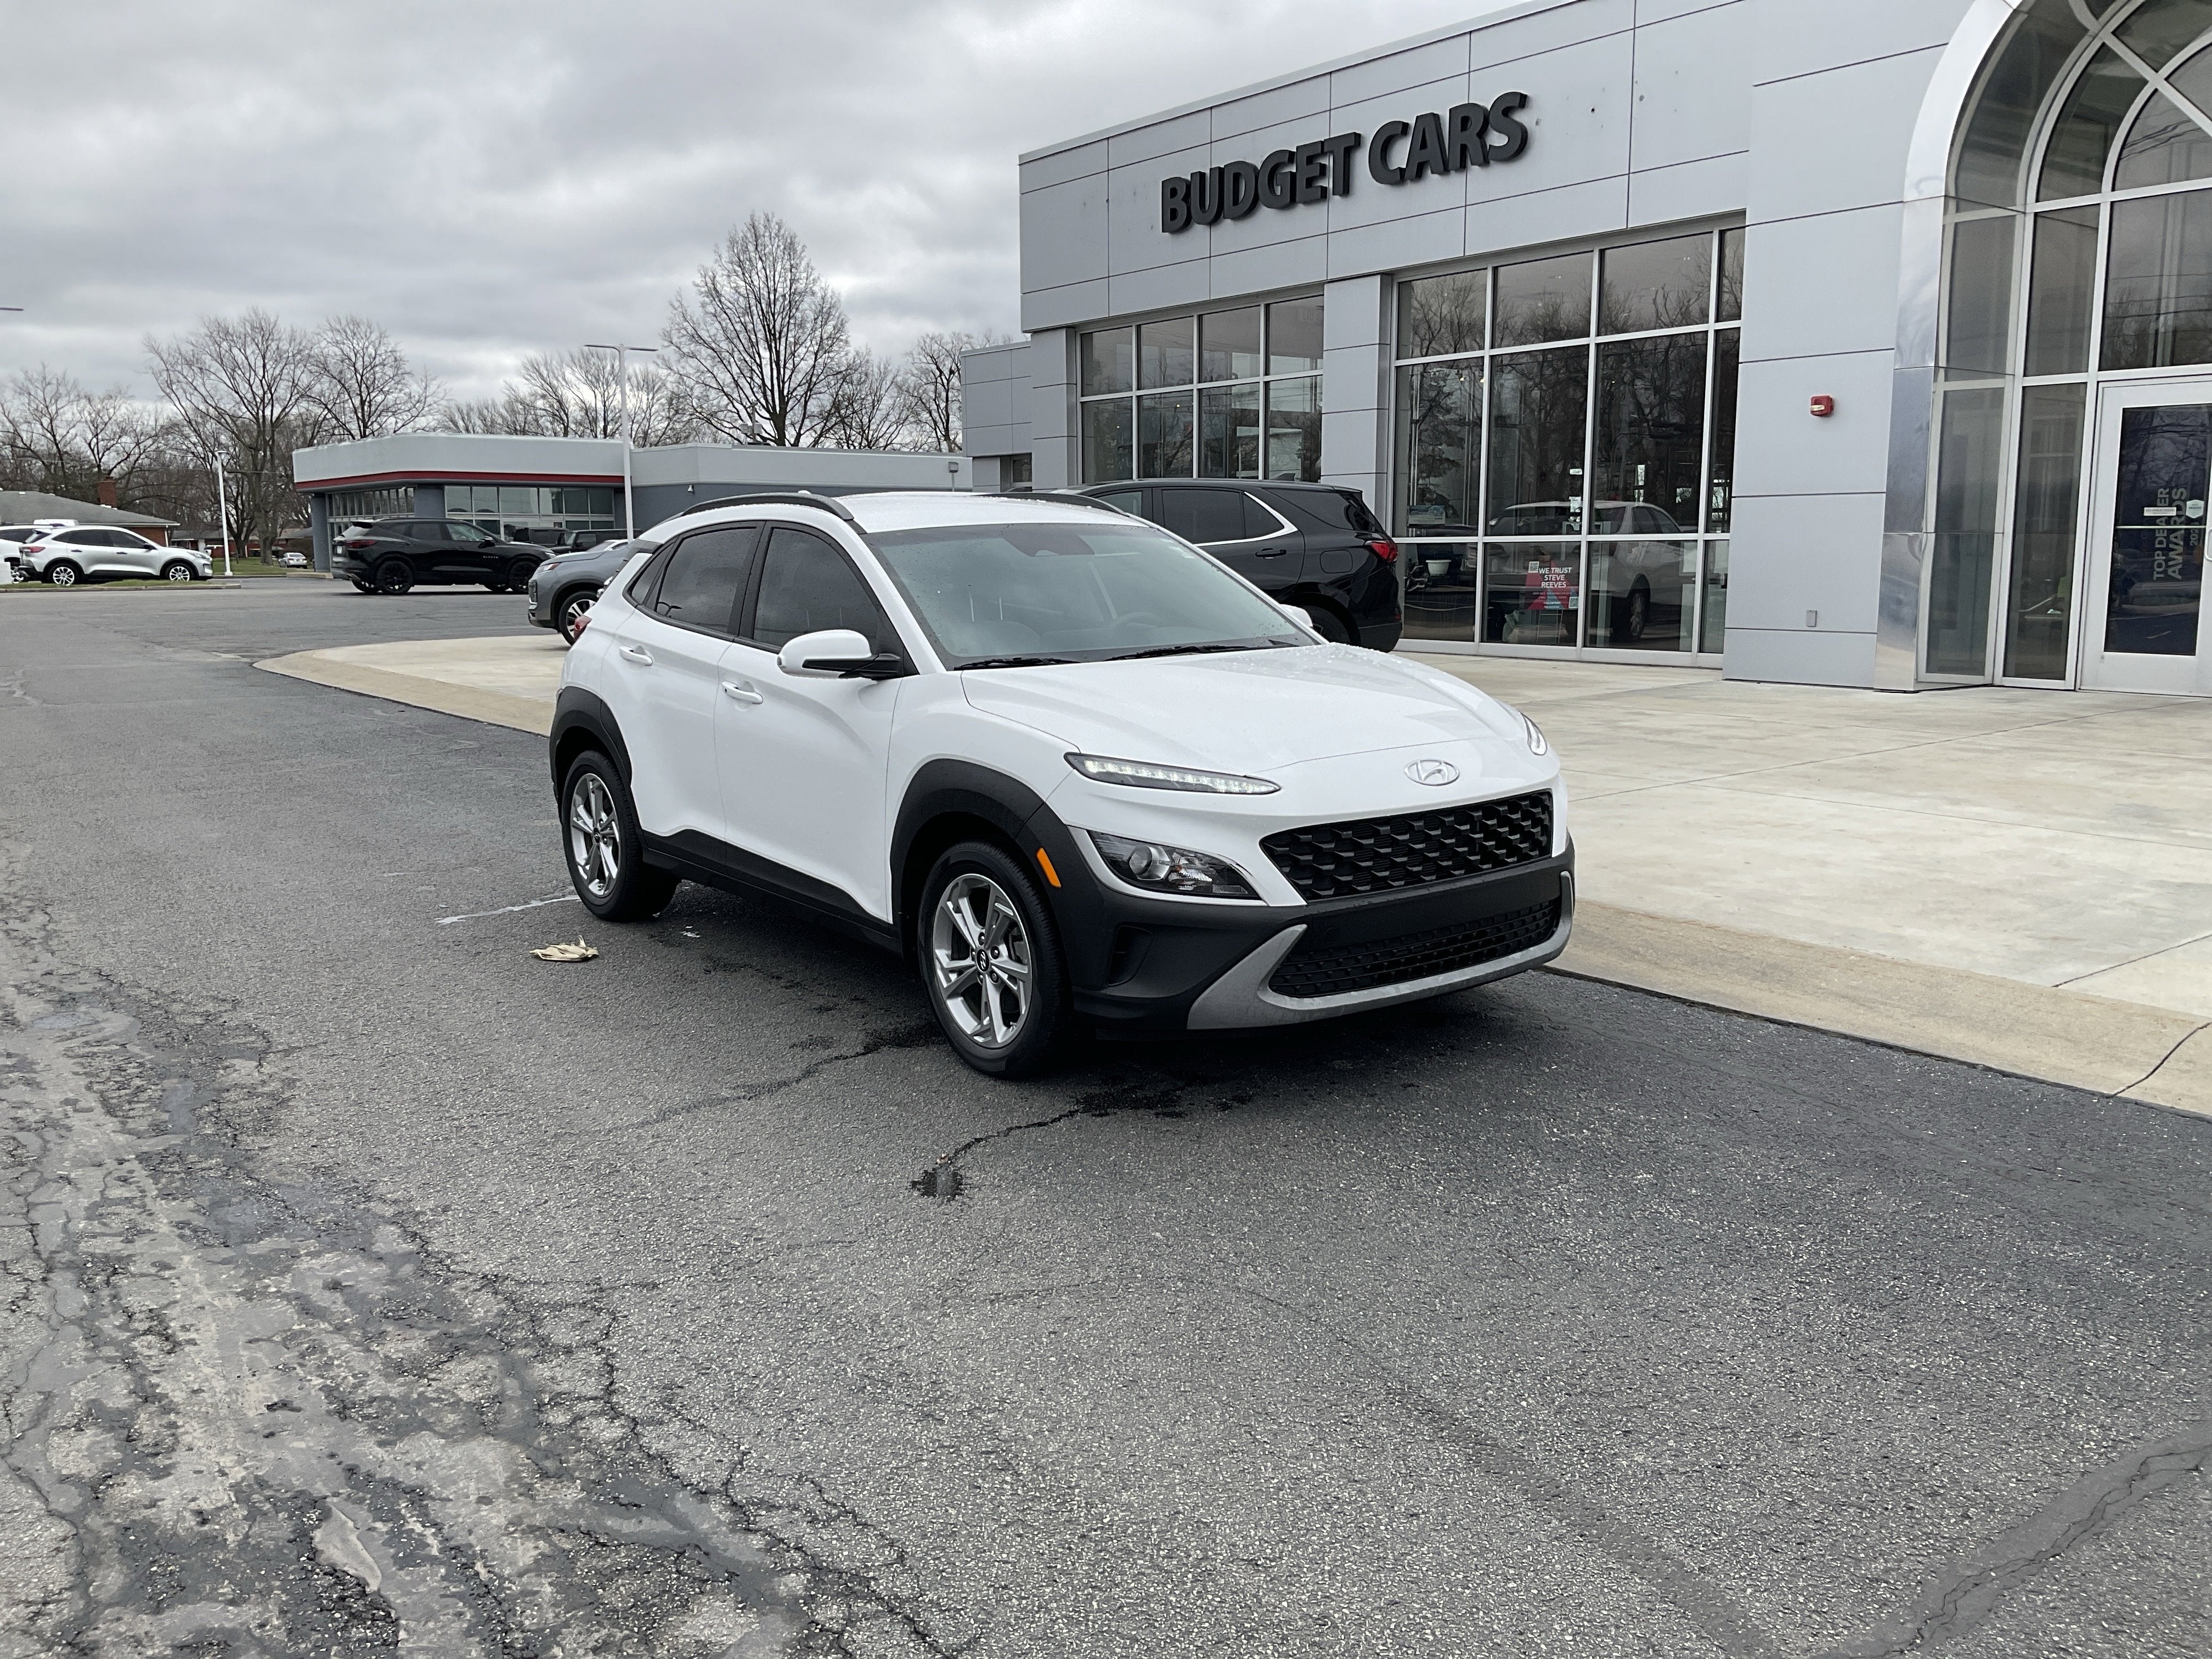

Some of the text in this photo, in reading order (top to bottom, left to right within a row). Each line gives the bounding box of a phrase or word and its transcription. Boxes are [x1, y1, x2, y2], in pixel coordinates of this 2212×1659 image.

[1161, 91, 1527, 233] BUDGET CARS
[2155, 488, 2169, 548] DEAER
[2168, 487, 2187, 580] AWARDS
[2153, 550, 2165, 580] TOP
